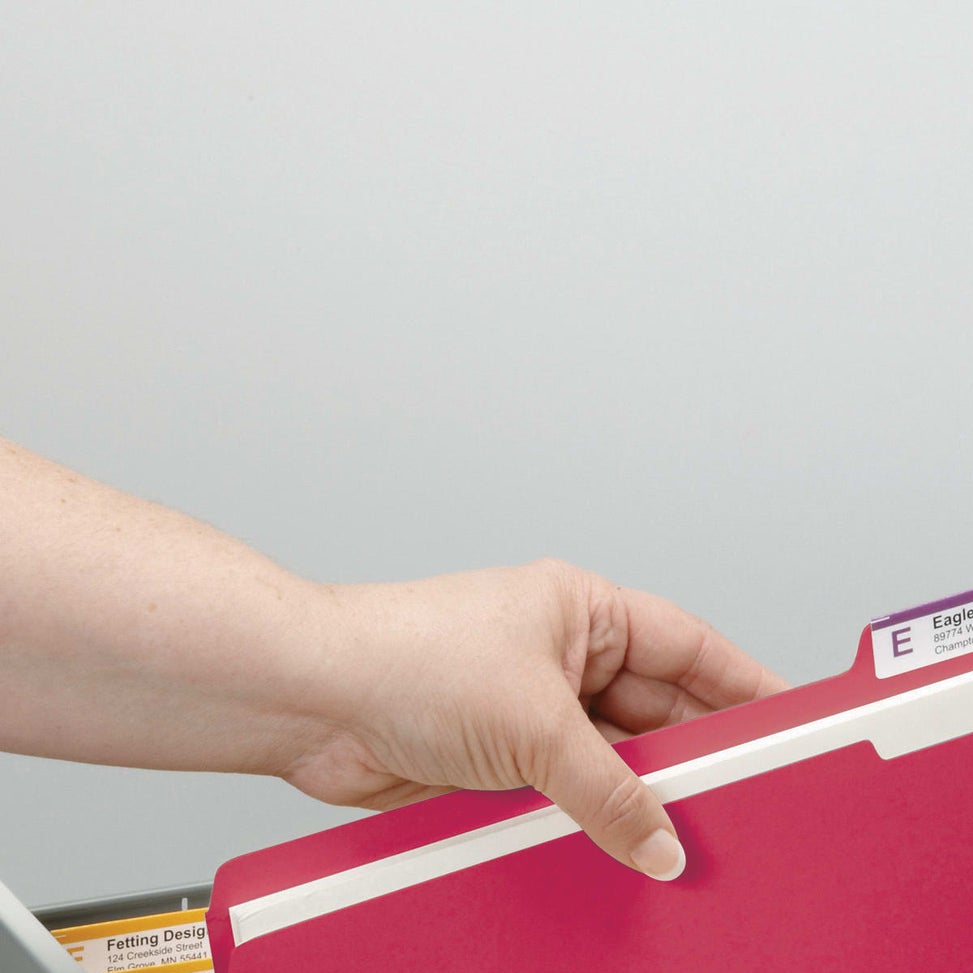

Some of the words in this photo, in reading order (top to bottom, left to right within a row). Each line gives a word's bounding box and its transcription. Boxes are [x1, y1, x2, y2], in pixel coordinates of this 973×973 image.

[892, 627, 913, 657] E
[933, 626, 963, 642] 89774
[106, 934, 159, 951] Fetting
[106, 953, 124, 963] 124
[126, 946, 173, 960] Creekside
[175, 941, 202, 952] Street
